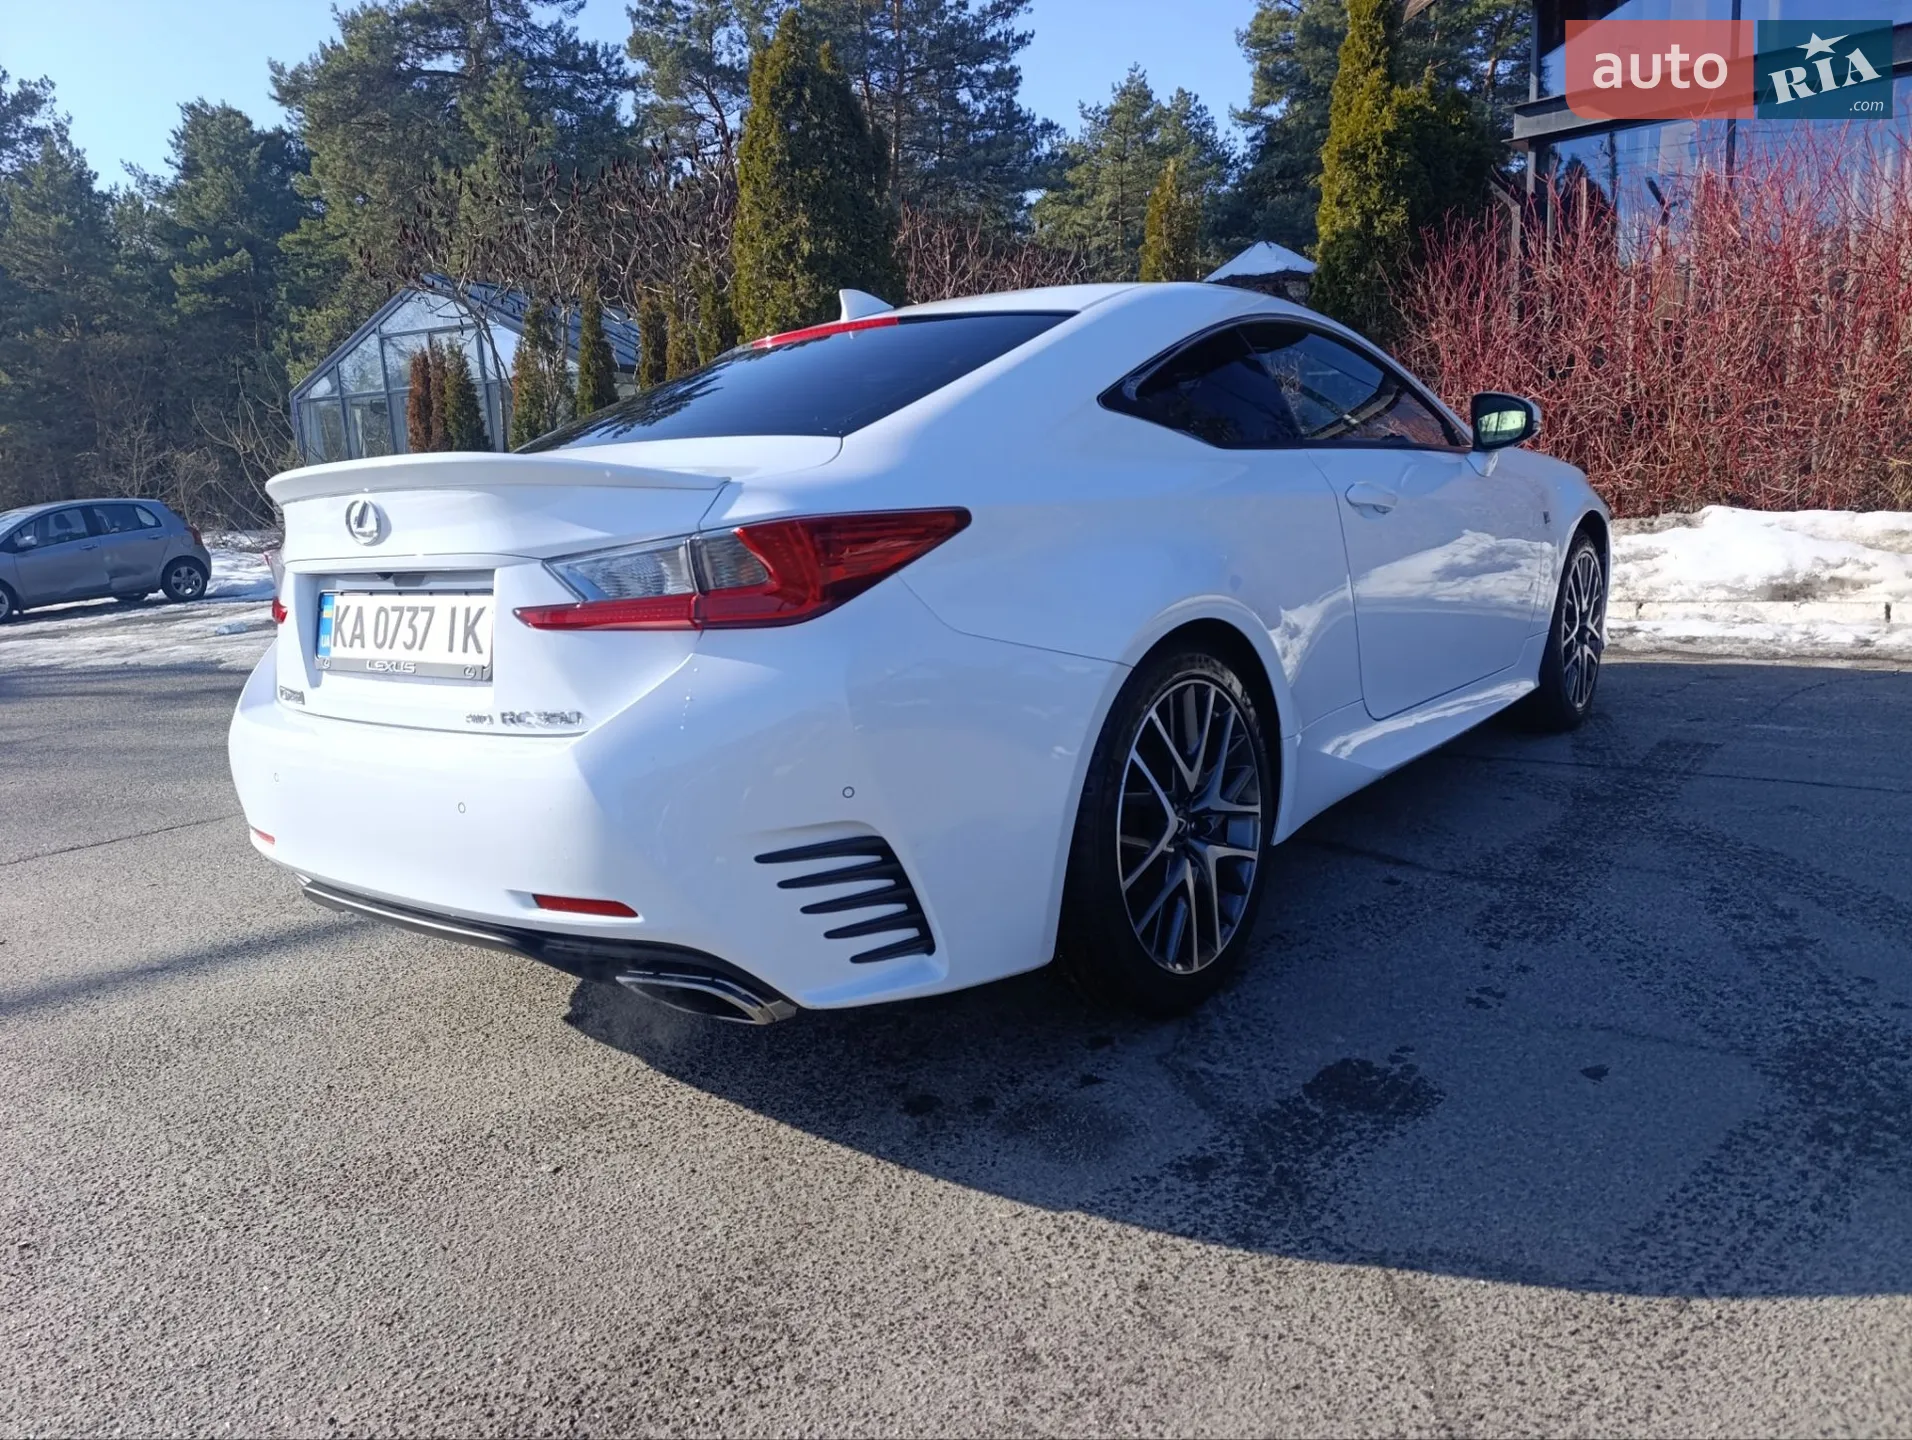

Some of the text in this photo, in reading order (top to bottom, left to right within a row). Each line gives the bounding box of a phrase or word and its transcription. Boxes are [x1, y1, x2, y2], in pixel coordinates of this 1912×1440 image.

[333, 605, 366, 649] KA
[373, 605, 436, 651] 0737
[366, 659, 417, 674] LEXUS
